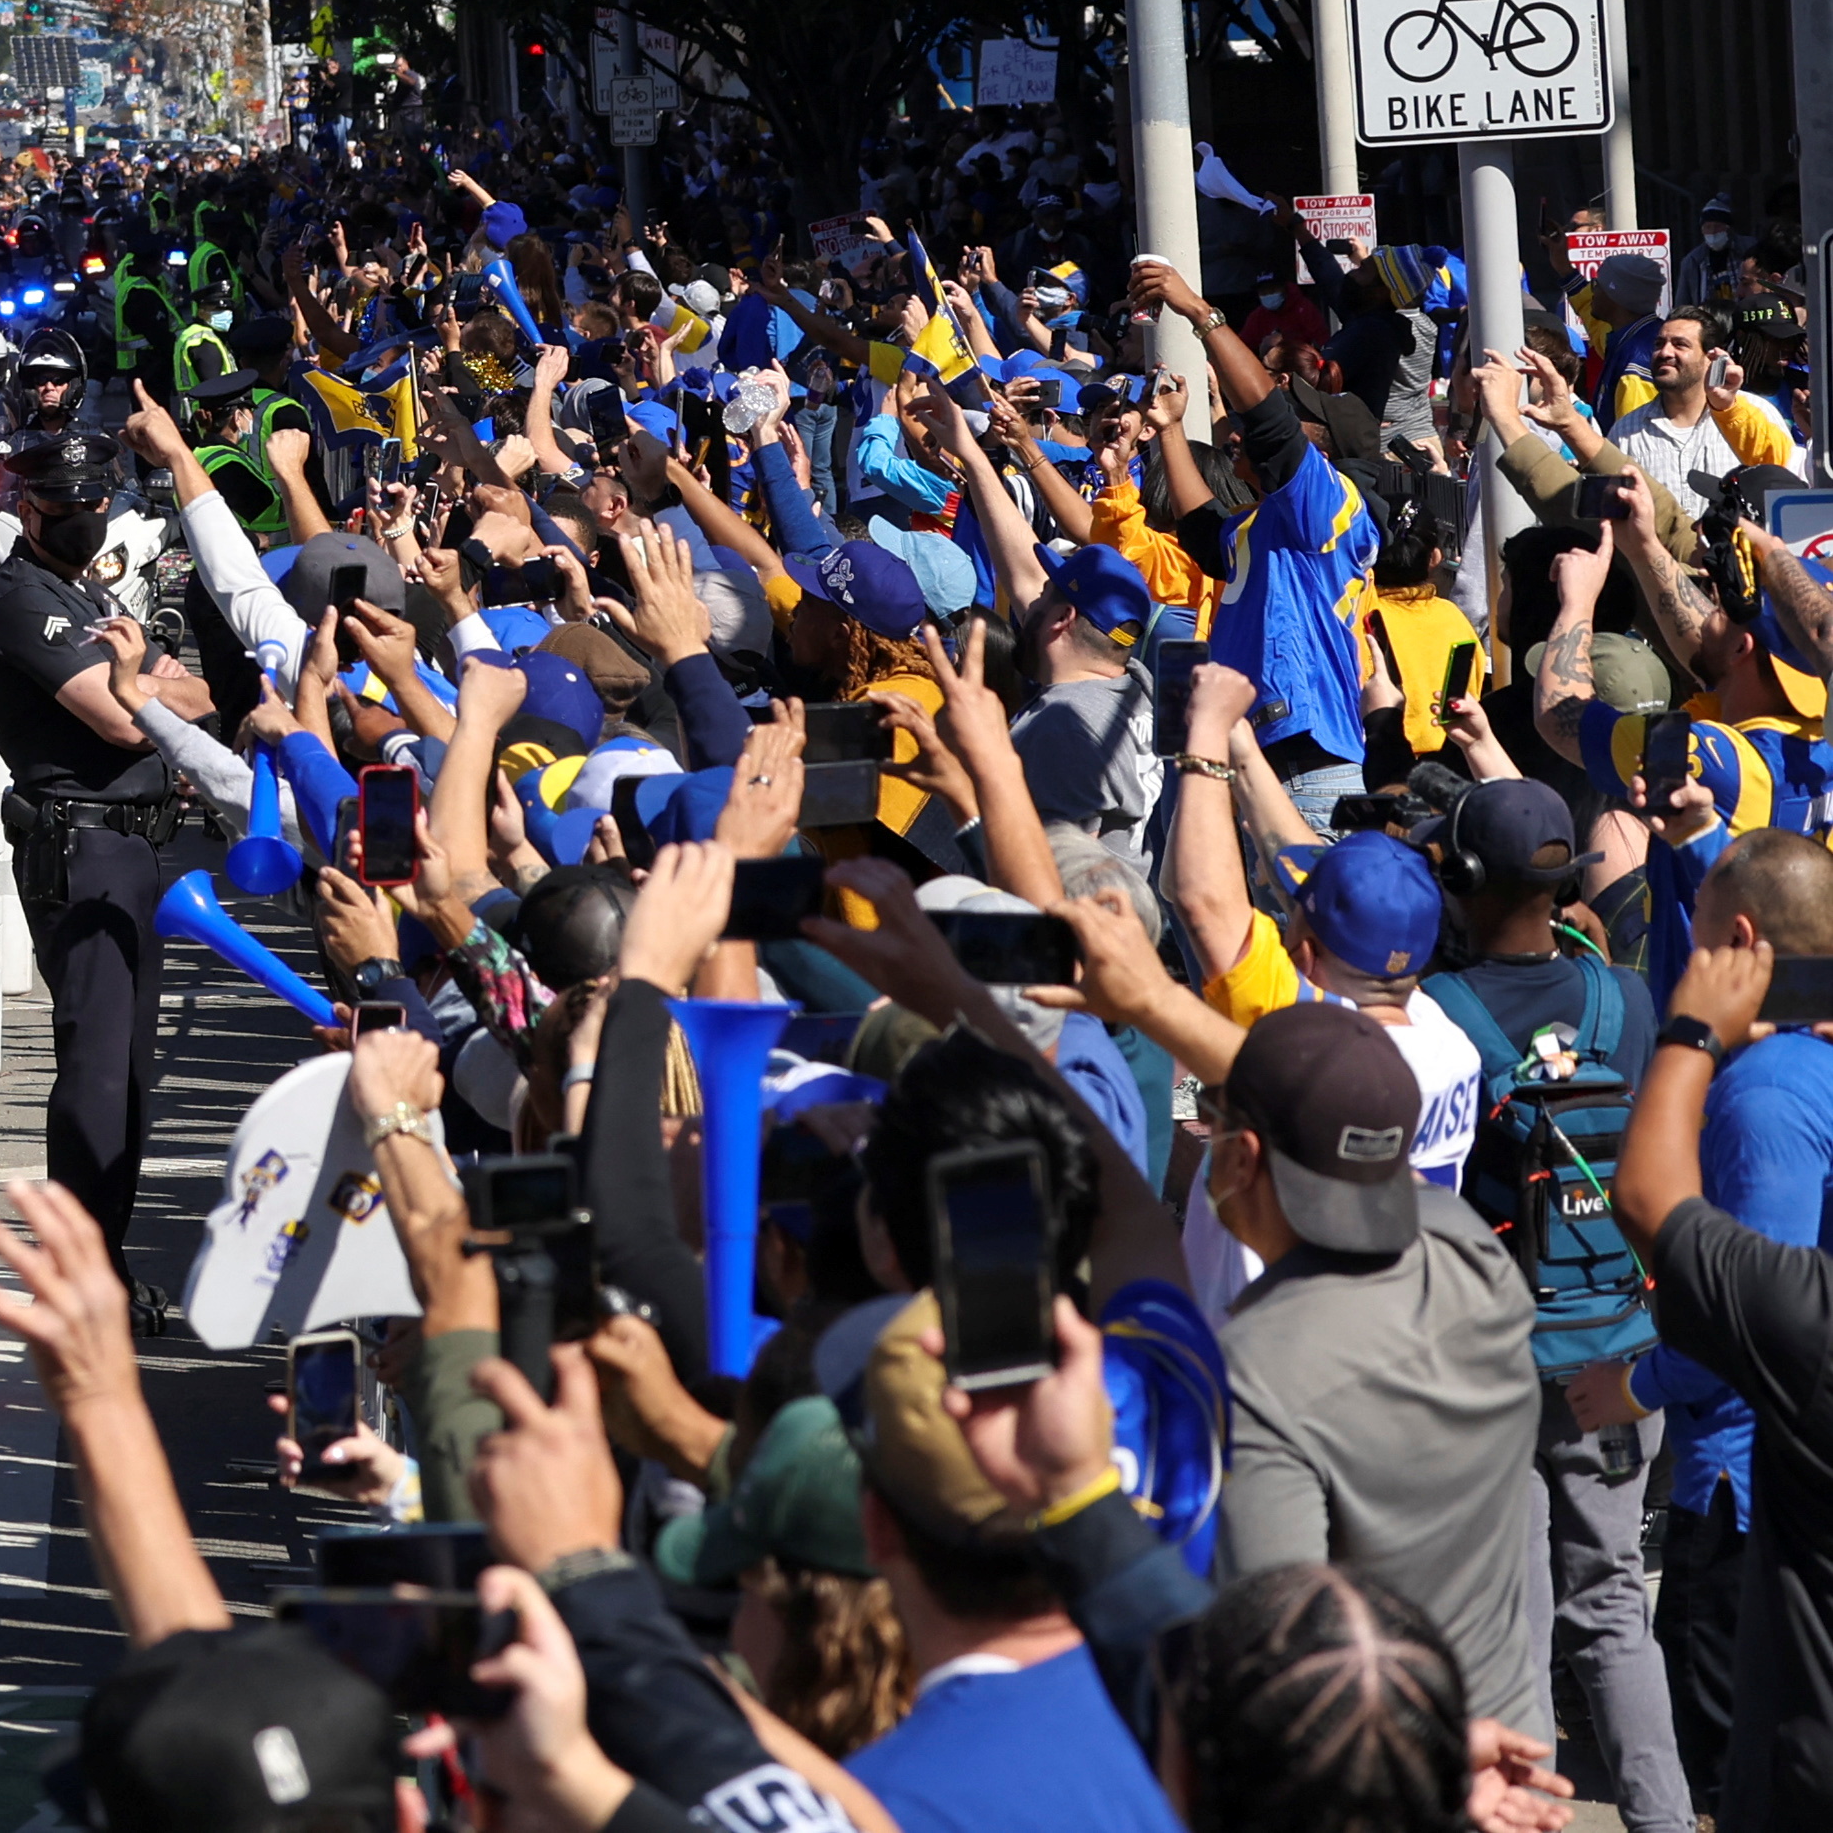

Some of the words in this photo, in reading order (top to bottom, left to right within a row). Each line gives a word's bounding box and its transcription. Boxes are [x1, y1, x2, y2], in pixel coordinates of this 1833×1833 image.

[1387, 92, 1469, 131] BIKE
[1485, 86, 1579, 126] LANE
[1303, 197, 1365, 208] TOW-AWAY
[1306, 208, 1363, 218] TEMPORARY
[1323, 221, 1372, 239] STOPPING
[1576, 233, 1656, 246] TOW-AWAY
